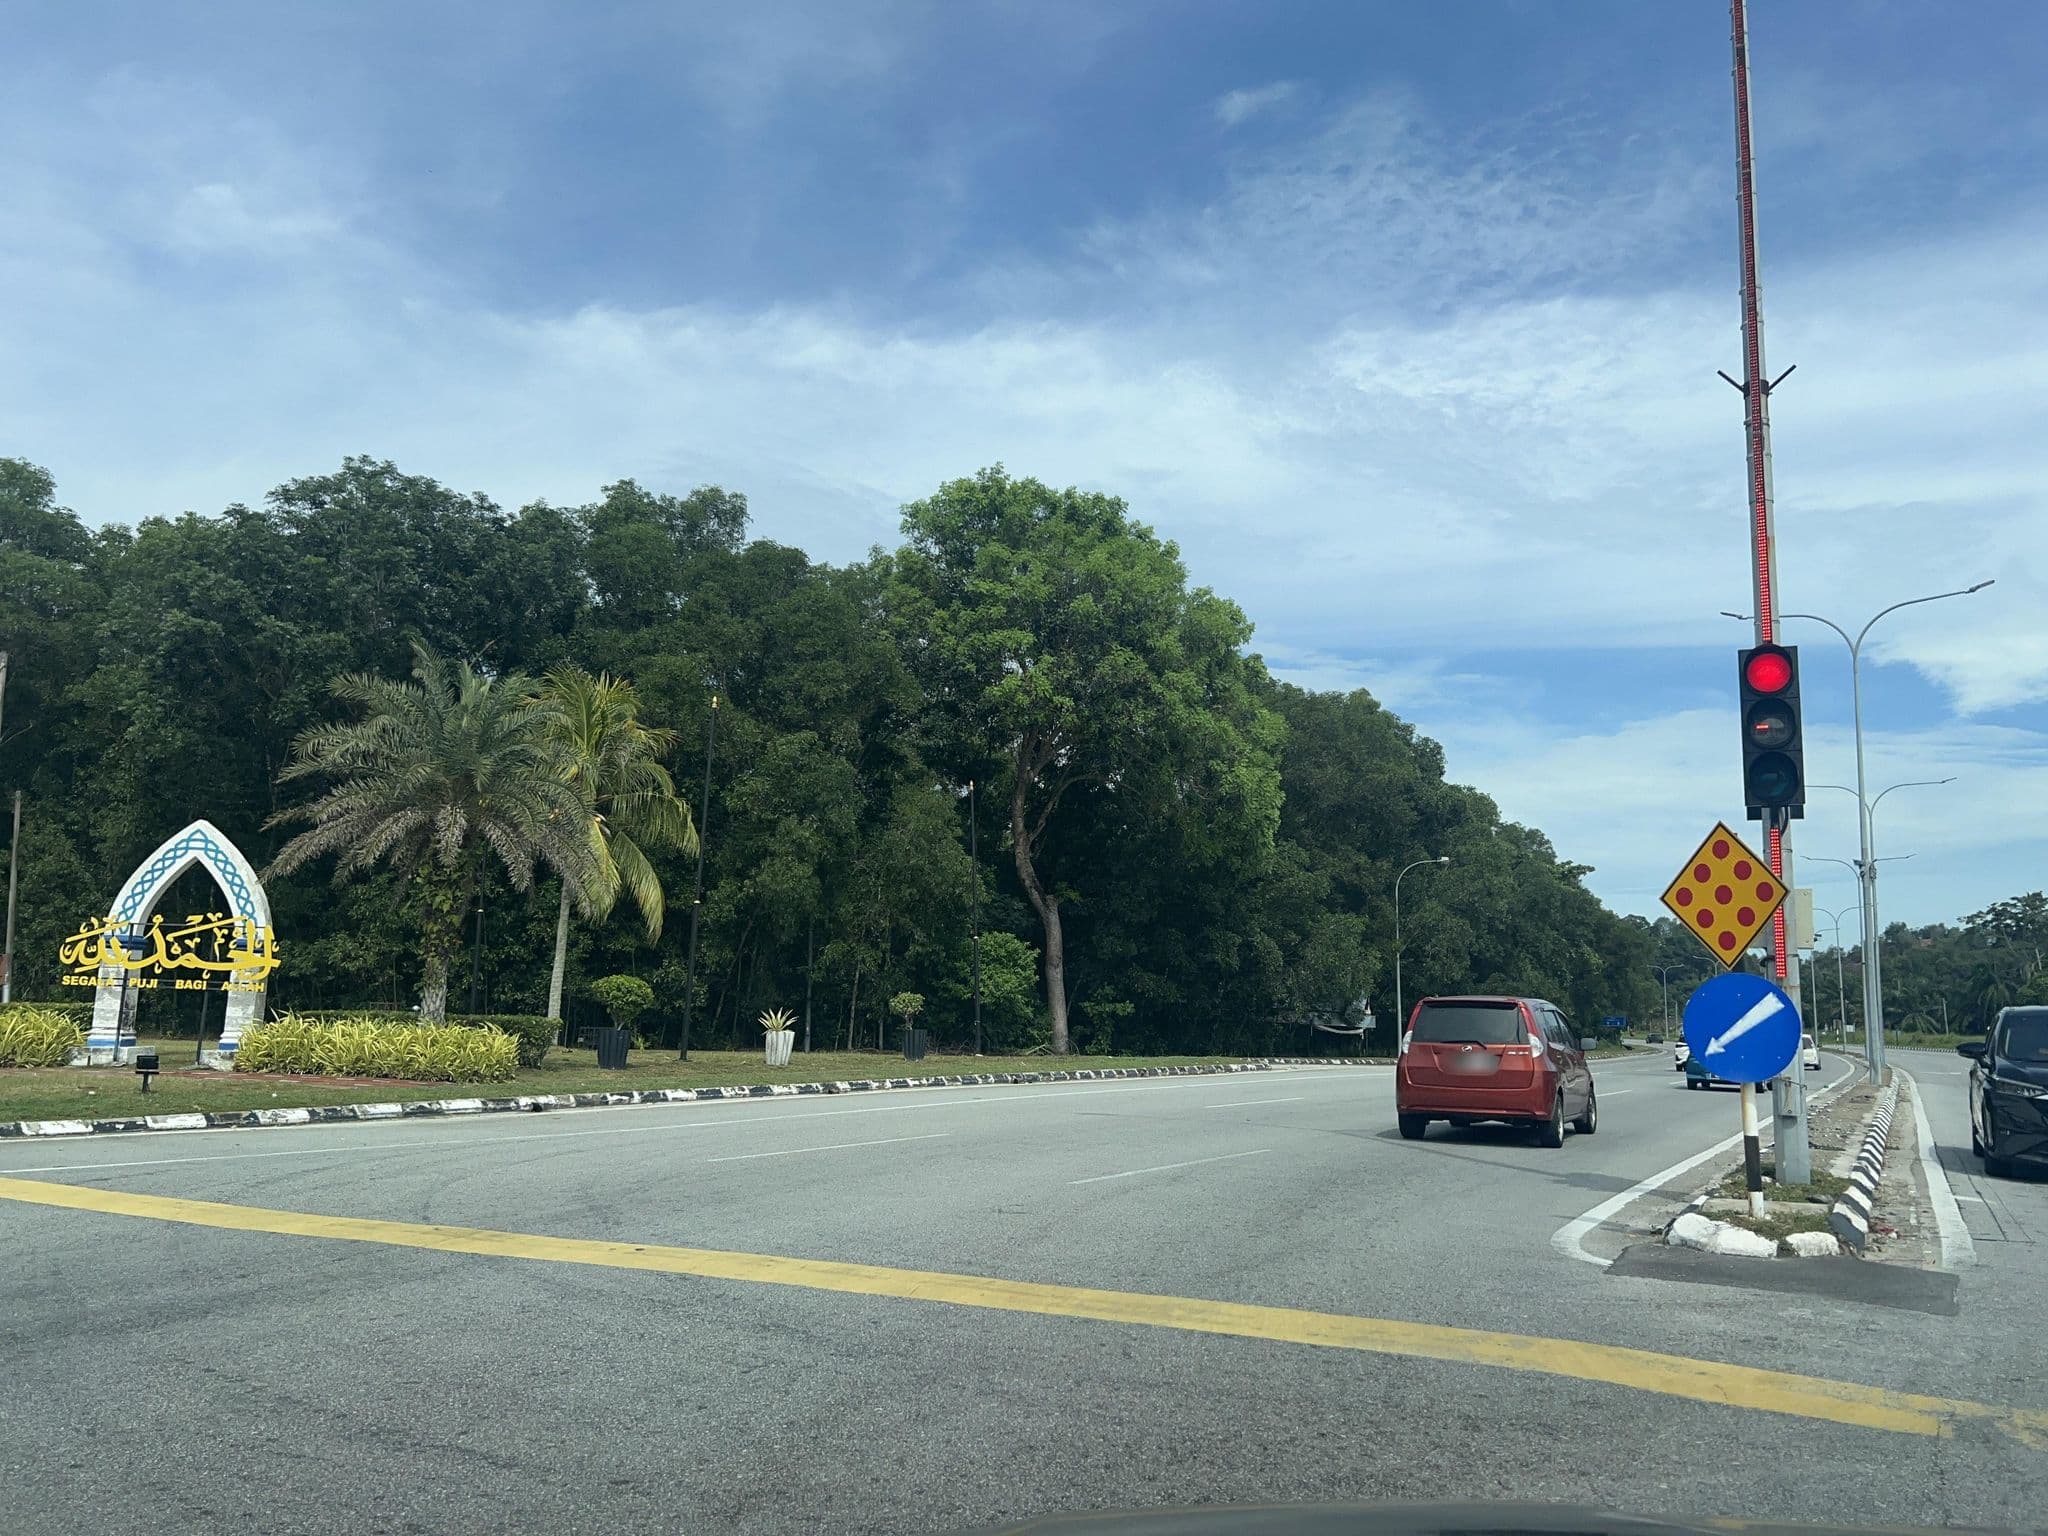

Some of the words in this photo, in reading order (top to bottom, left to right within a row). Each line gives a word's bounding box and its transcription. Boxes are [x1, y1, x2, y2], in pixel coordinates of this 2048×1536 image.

[62, 975, 115, 987] SEGALA
[128, 977, 158, 989] PUJI
[175, 979, 207, 991] BAGI
[220, 981, 265, 993] ALLAH
